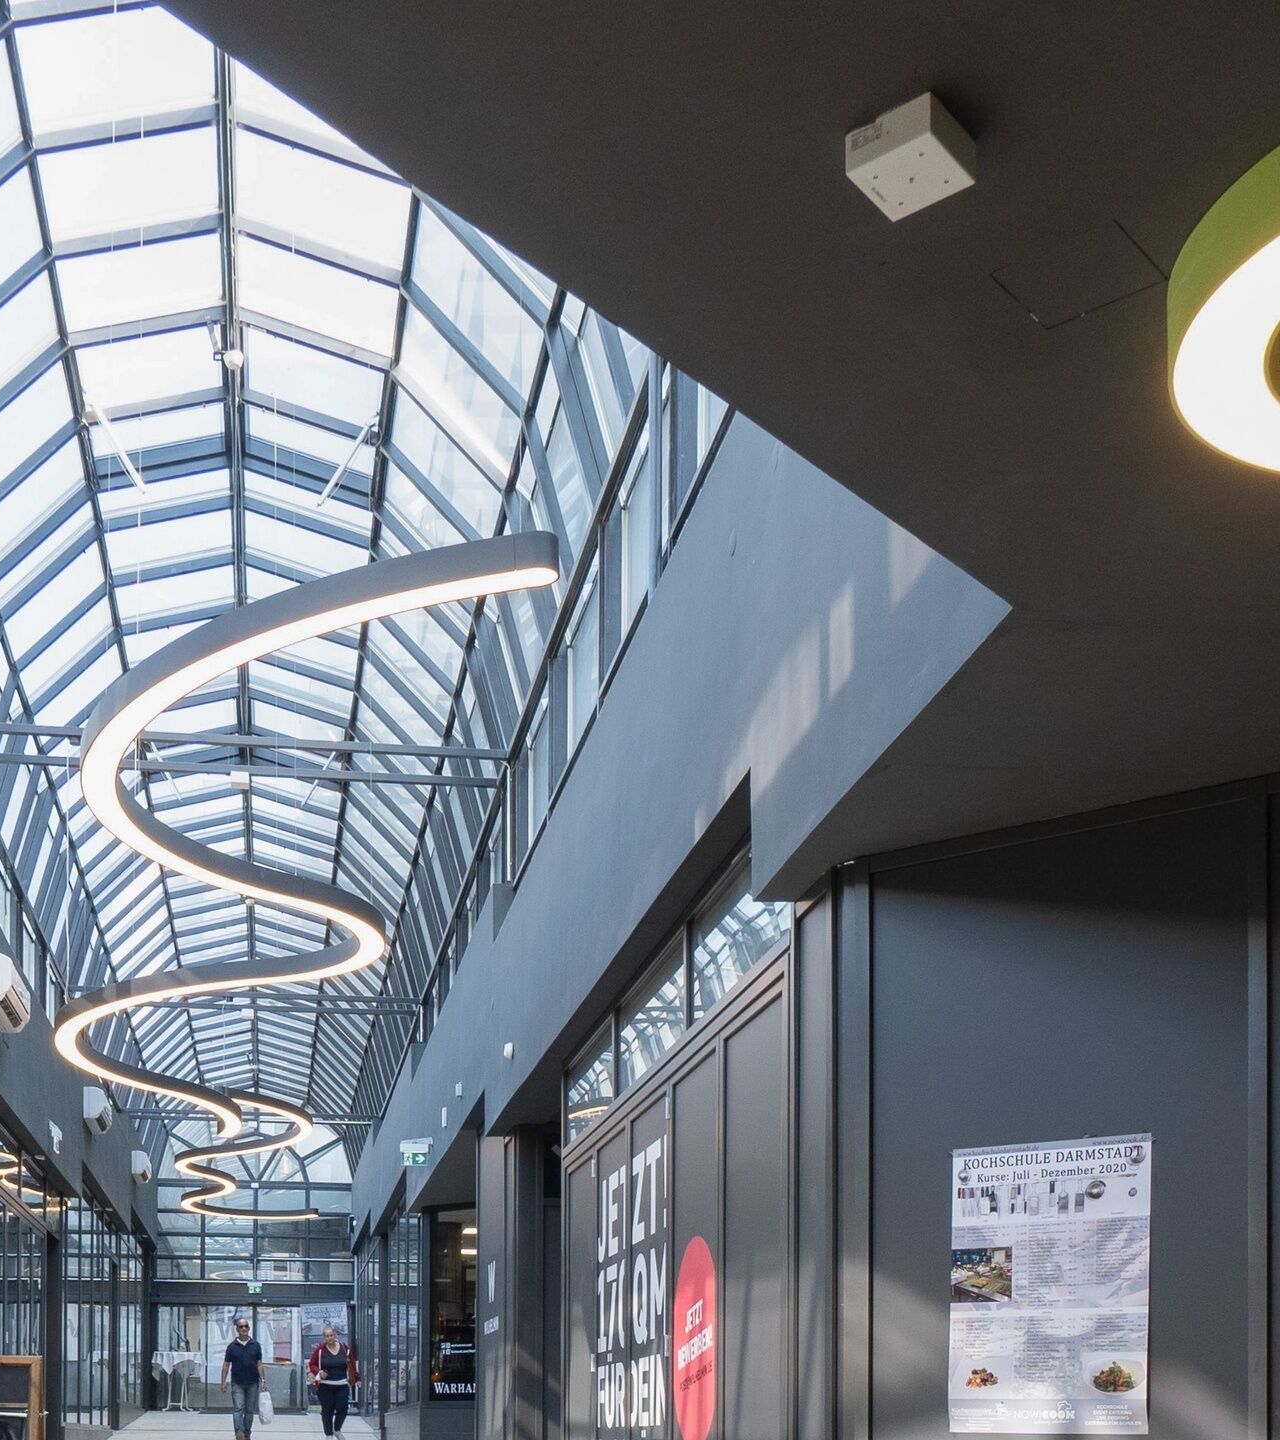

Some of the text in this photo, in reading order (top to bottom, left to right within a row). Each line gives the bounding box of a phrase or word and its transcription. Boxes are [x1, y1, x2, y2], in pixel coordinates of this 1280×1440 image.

[963, 1145, 1143, 1171] KOCHSCHULE DARMSTADT
[977, 1173, 1009, 1183] Kurse:
[1012, 1169, 1030, 1182] Juli
[1041, 1166, 1095, 1178] Dezember
[1099, 1163, 1127, 1174] 2020
[632, 1242, 667, 1345] QM
[597, 1353, 625, 1429] FÜR
